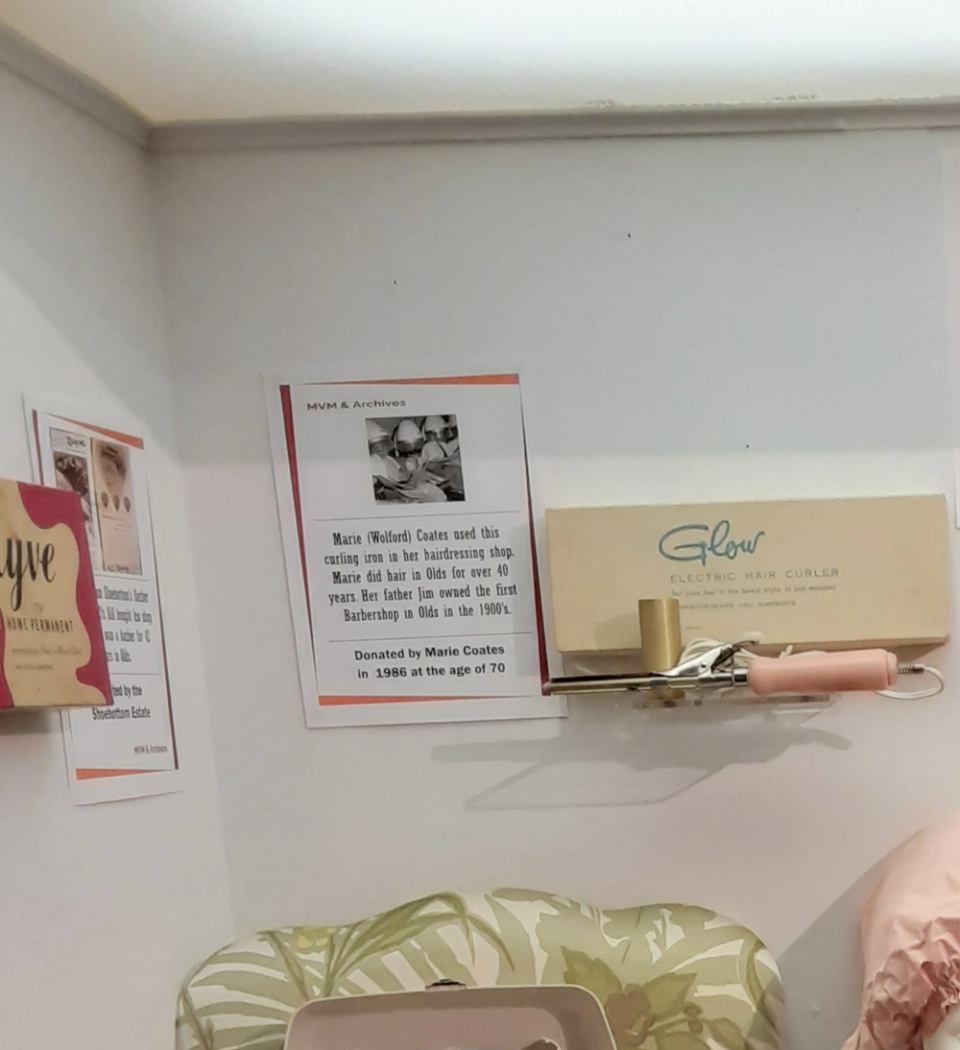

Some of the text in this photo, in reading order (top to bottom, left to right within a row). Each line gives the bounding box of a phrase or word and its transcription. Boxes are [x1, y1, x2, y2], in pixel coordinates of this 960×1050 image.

[307, 402, 337, 410] MVM
[353, 400, 406, 408] Archives
[333, 526, 499, 545] Marie (Wolford) Coates used this
[658, 520, 765, 567] Glow
[324, 545, 514, 567] curling iron in her hairdressing shop.
[0, 538, 56, 611] yve
[332, 564, 508, 584] Marie did hair in Olds for over 40
[670, 568, 839, 583] ELECTRIC HAIR CURLER
[361, 589, 378, 602] Her
[384, 588, 412, 601] father
[418, 587, 434, 602] Jim
[439, 585, 471, 598] owned
[476, 584, 490, 597] the
[496, 583, 517, 596] first
[344, 608, 399, 622] Barbershop
[404, 607, 413, 619] in
[418, 605, 438, 618] Olds
[444, 608, 453, 617] in
[458, 604, 474, 616] the
[8, 618, 73, 633] HOME PERMANENT
[355, 646, 504, 660] Donated by Marie Coates
[358, 663, 505, 679] in 1986 at the age of 70
